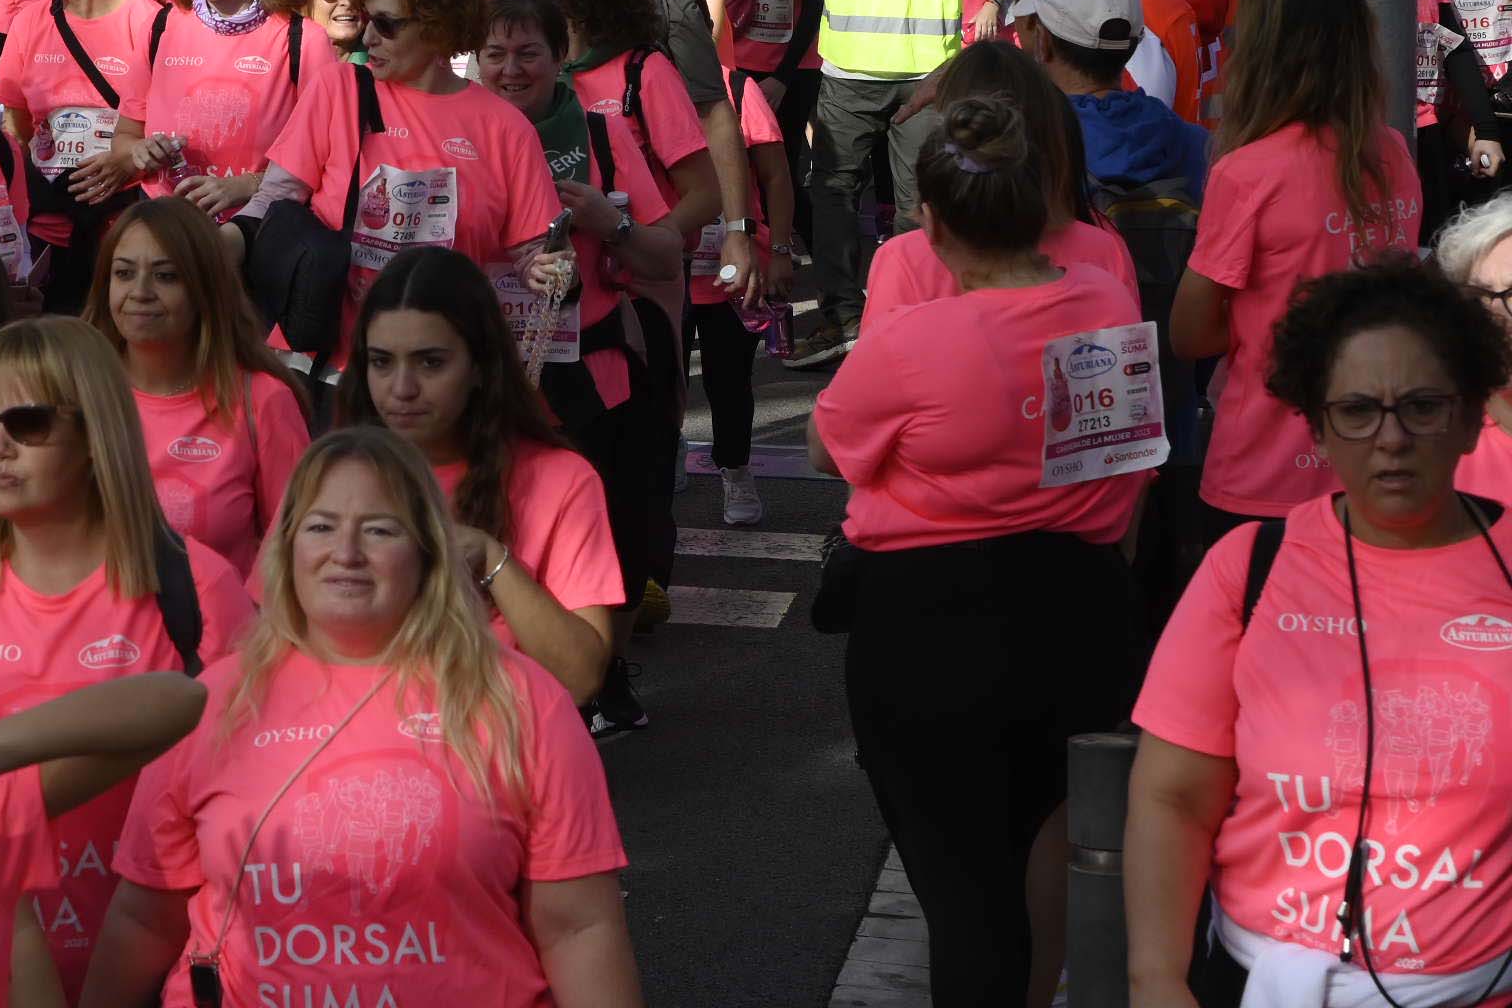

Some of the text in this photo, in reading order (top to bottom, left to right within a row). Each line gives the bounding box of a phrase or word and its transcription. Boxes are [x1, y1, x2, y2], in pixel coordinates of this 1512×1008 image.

[1461, 17, 1490, 29] 016
[34, 54, 65, 65] OYSHO
[164, 56, 204, 67] OYSHO
[57, 141, 85, 154] 016
[393, 212, 422, 226] 016
[1121, 345, 1148, 354] SUMA
[1074, 388, 1115, 412] 016
[1078, 415, 1111, 433] 27213
[171, 443, 220, 457] ASTURIANA
[1114, 448, 1158, 463] Santander
[1277, 613, 1368, 636] OYSHO
[253, 724, 334, 748] OYSHO
[1267, 773, 1330, 813] TU
[1279, 832, 1485, 890] DORSAL
[244, 862, 303, 906] TU
[255, 921, 446, 966] DORSAL
